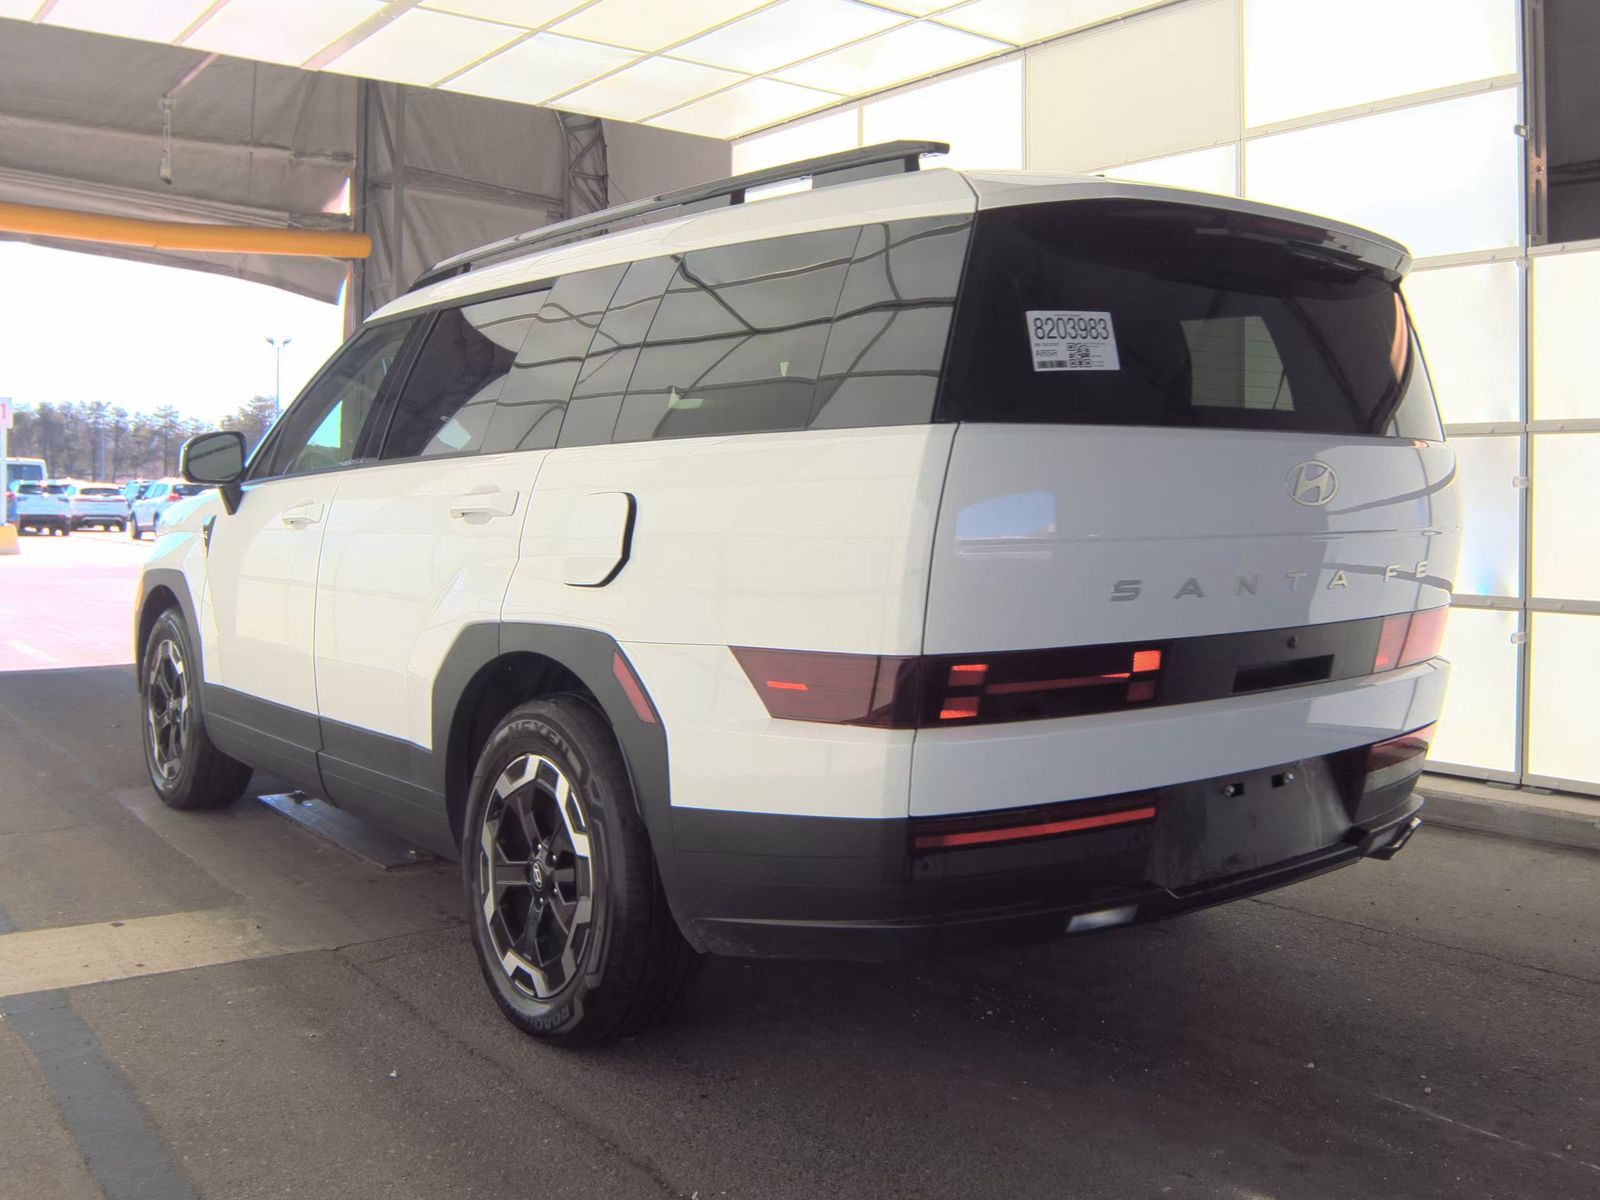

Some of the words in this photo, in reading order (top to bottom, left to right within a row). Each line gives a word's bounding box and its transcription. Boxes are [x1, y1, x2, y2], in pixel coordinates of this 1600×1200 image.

[1033, 317, 1109, 340] 8203983
[1110, 569, 1348, 602] SANTA
[1382, 560, 1429, 583] FE
